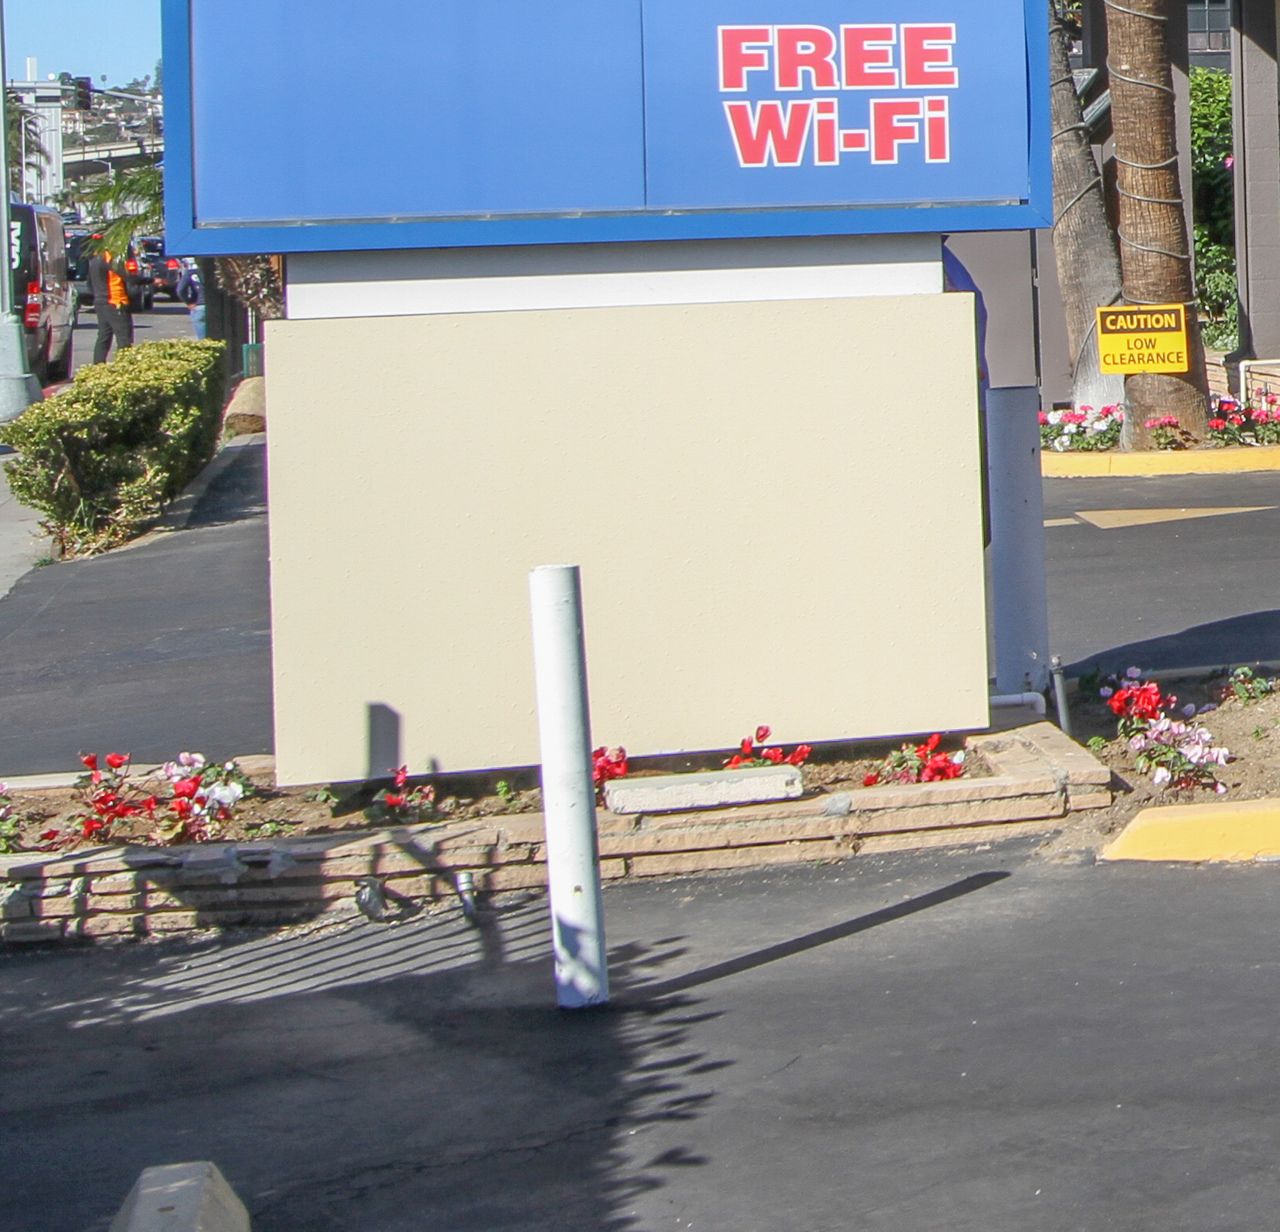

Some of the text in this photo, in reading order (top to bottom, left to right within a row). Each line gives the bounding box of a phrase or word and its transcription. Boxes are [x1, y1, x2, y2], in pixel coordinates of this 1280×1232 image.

[717, 23, 959, 92] FREE
[722, 95, 950, 168] Wi-Fi
[1105, 313, 1176, 330] CAUTION
[1126, 338, 1157, 351] LOW
[1103, 351, 1184, 366] CLEARANCE
